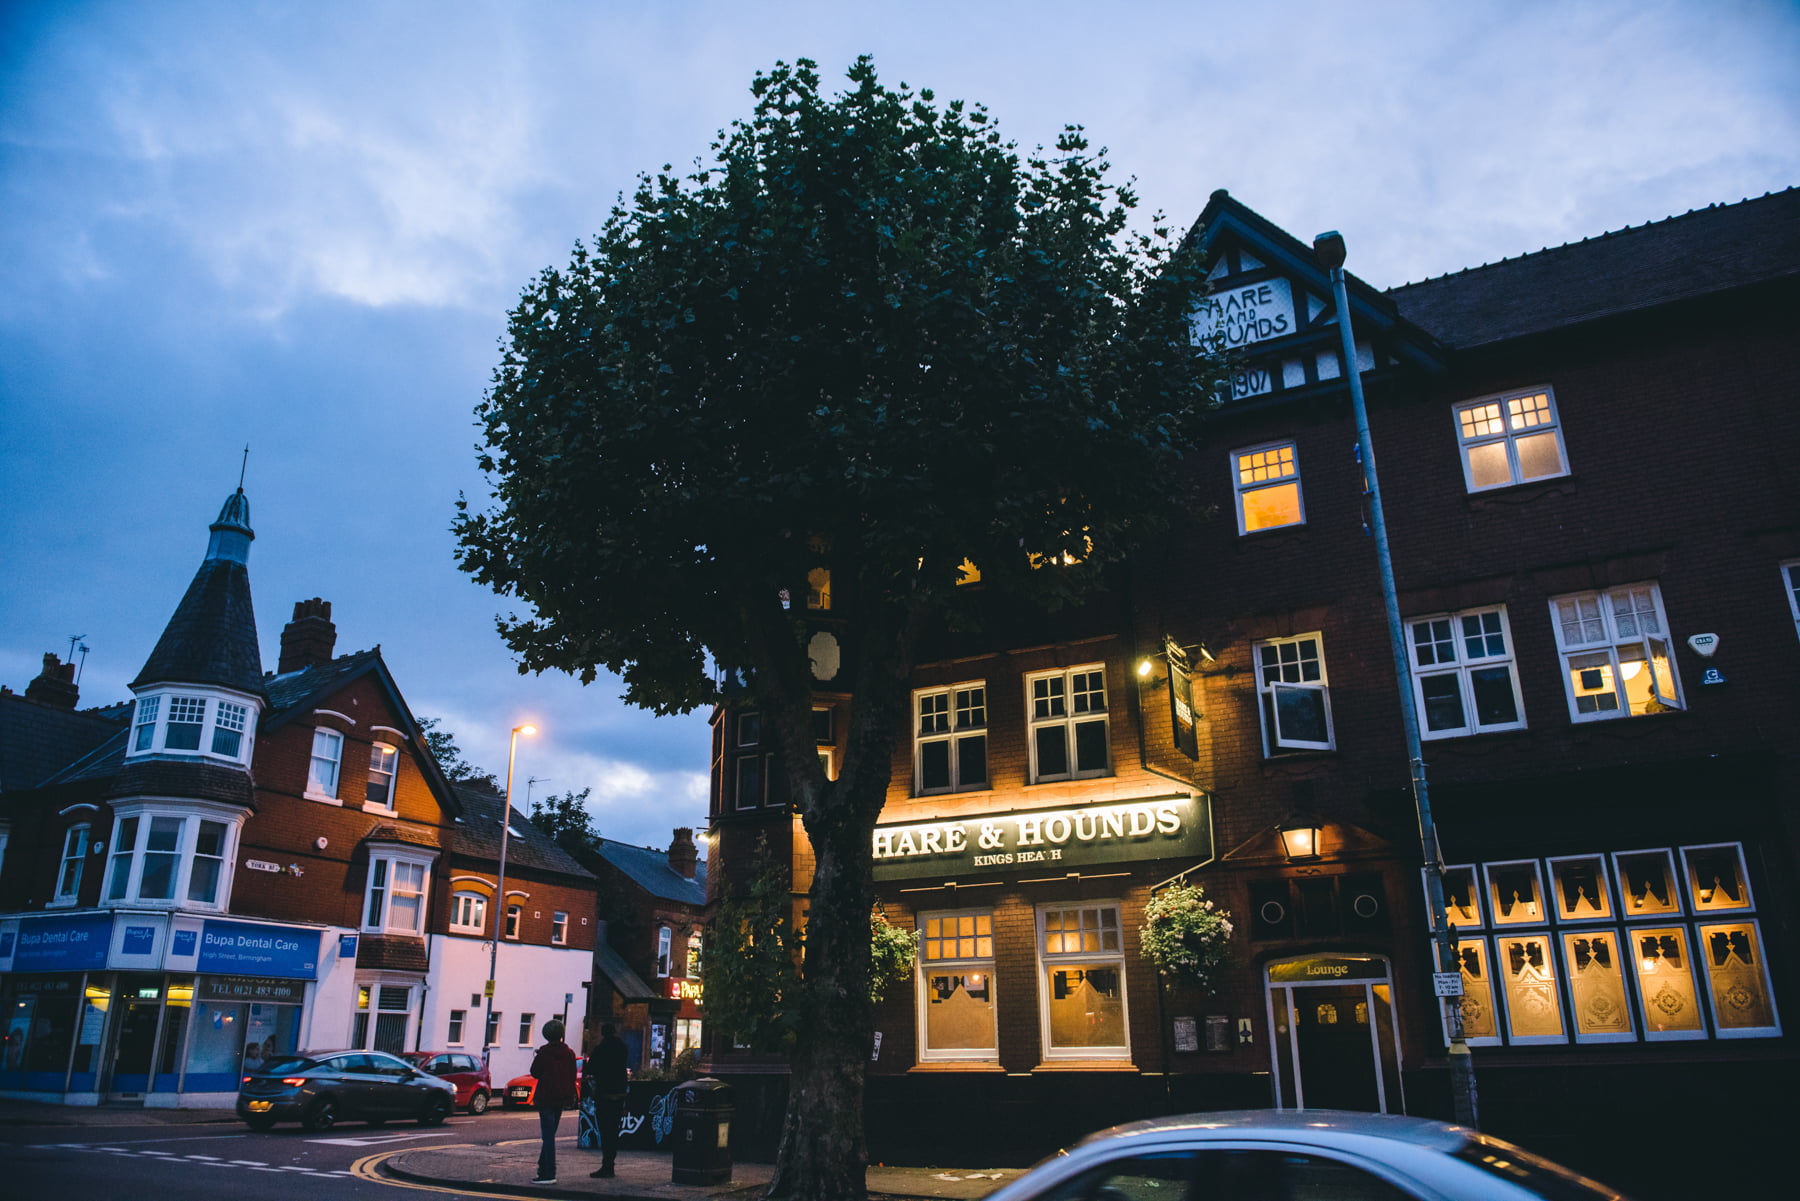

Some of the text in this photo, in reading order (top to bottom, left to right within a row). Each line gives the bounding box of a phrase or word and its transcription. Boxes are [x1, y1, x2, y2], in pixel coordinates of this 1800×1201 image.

[1208, 286, 1272, 318] HARE
[1226, 309, 1256, 327] AND
[1200, 314, 1288, 349] HOUNDS
[872, 804, 1181, 859] HARE & HOUNDS
[974, 849, 1062, 866] KINGS HEAH
[42, 931, 68, 944] Dental
[70, 930, 89, 942] Care
[205, 933, 299, 951] Bupa Dental Care
[1306, 965, 1348, 976] Lounge
[211, 984, 231, 994] TEL
